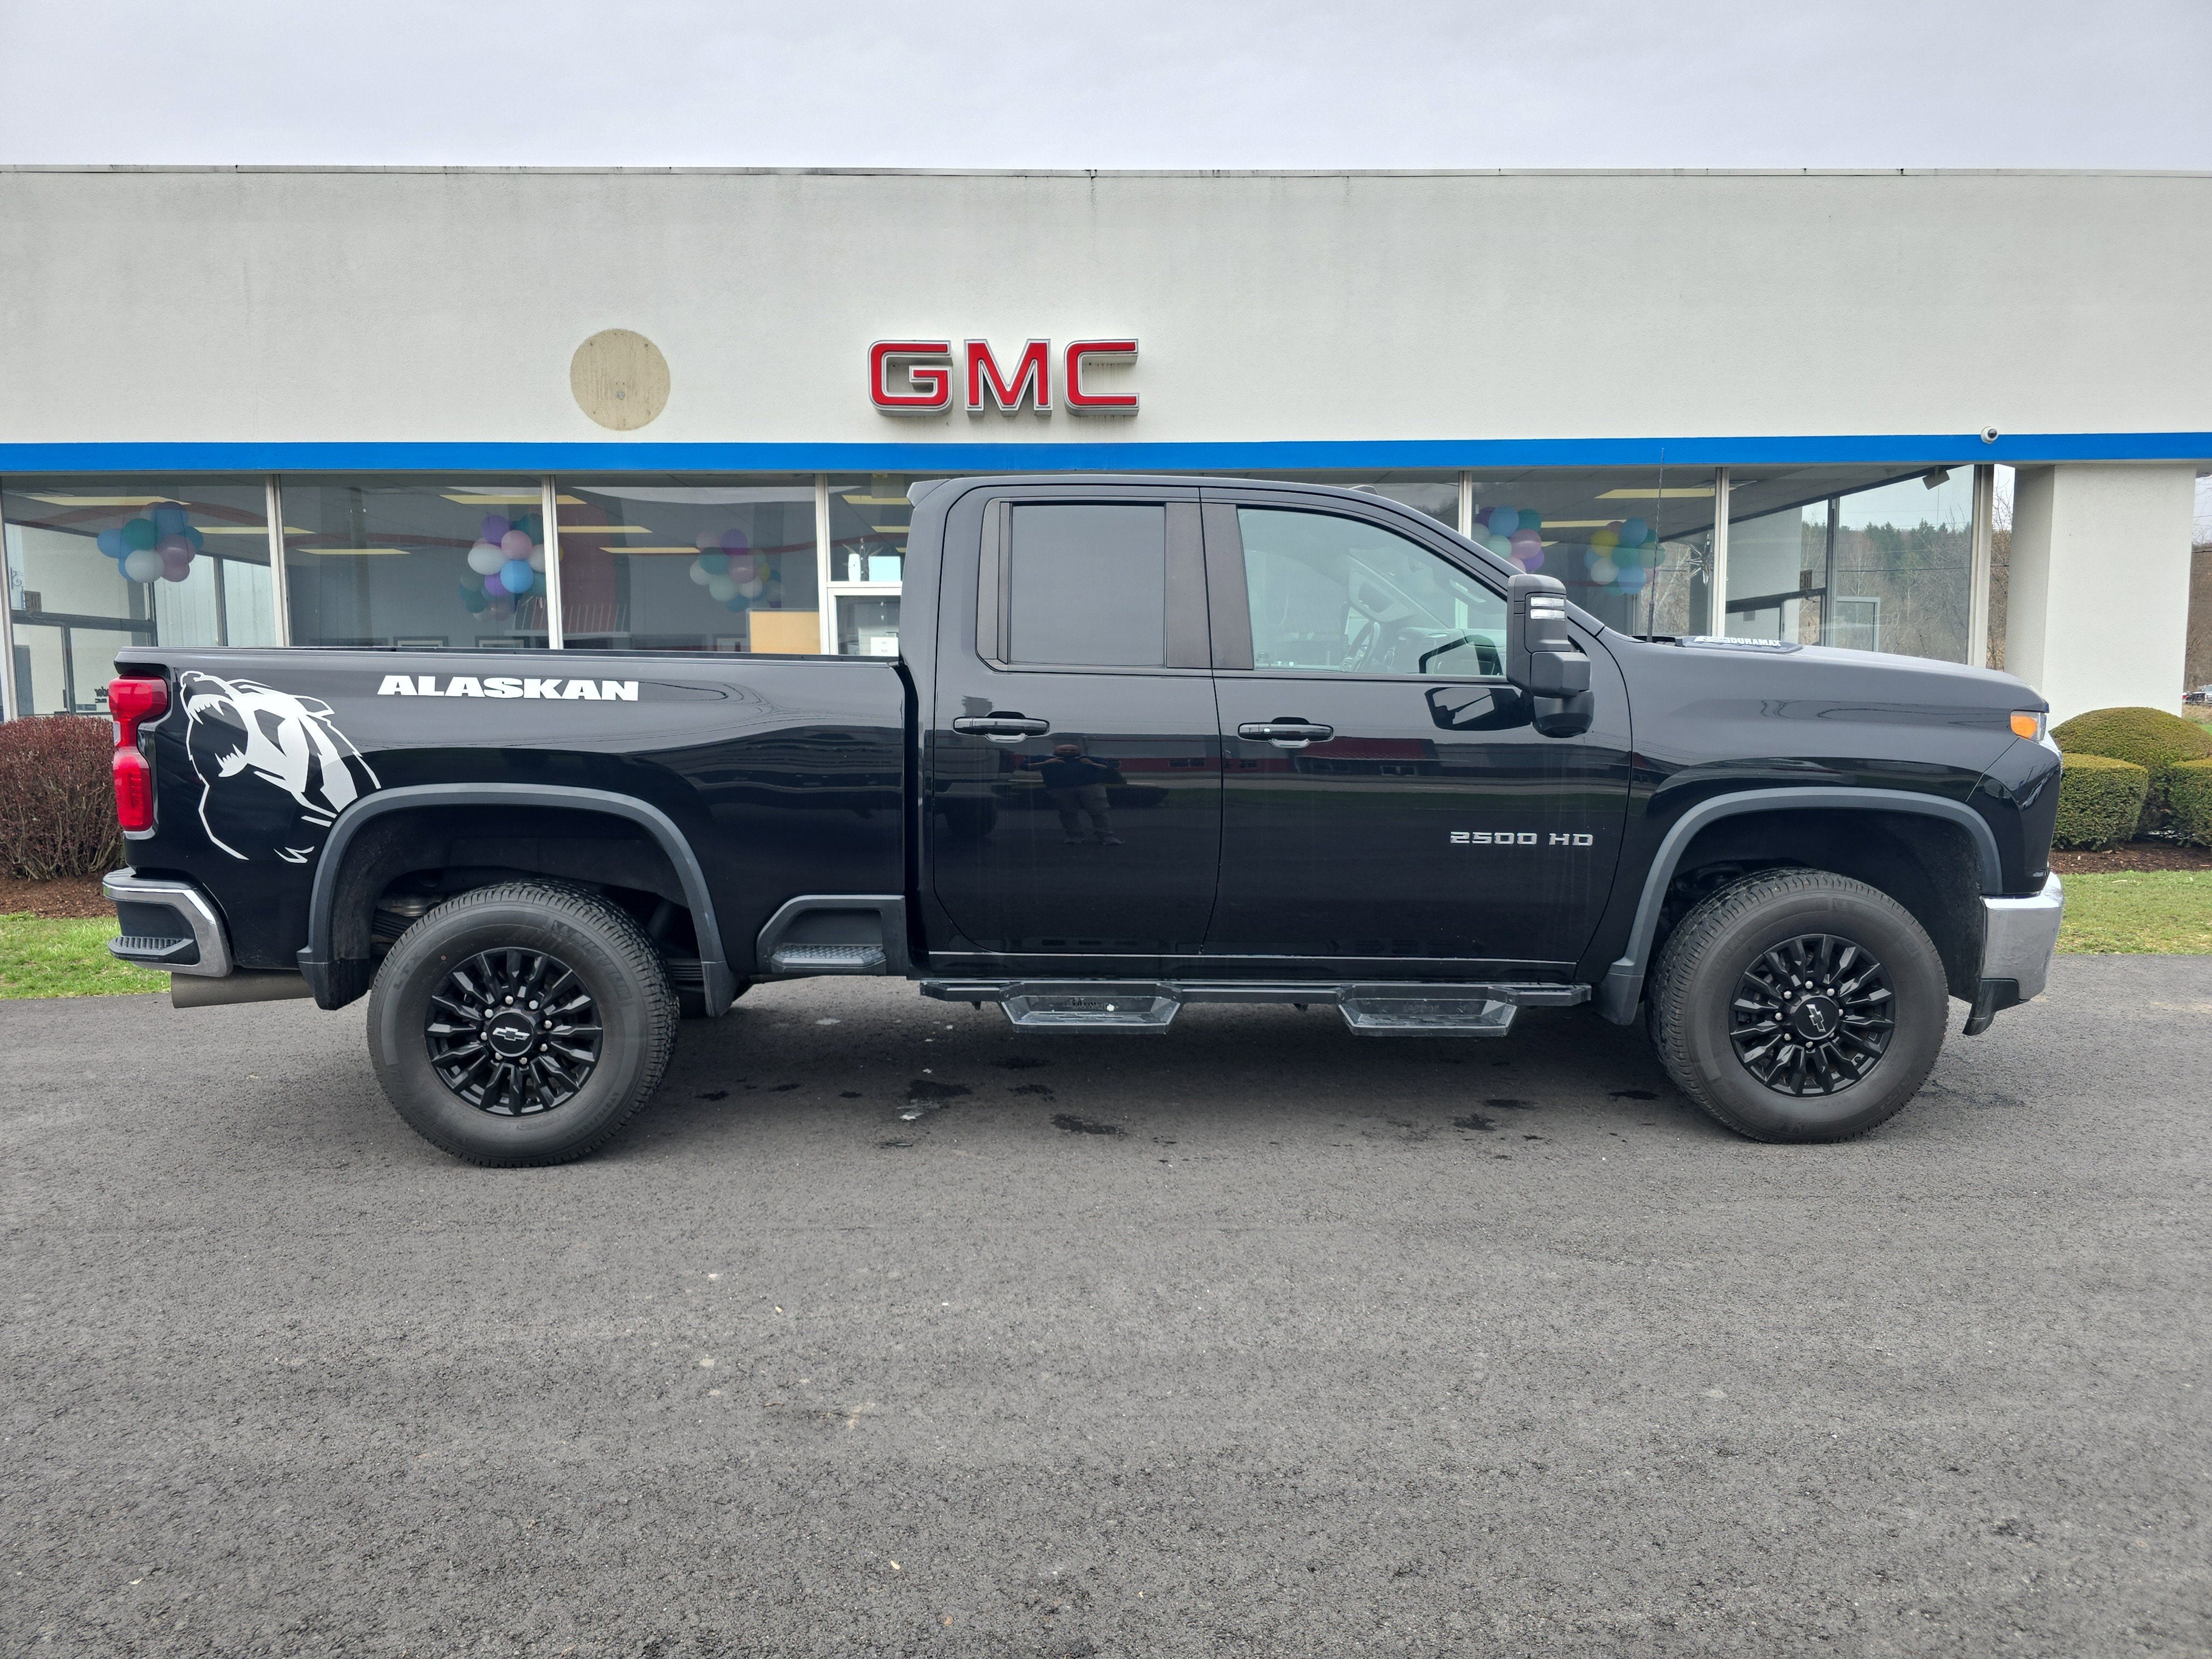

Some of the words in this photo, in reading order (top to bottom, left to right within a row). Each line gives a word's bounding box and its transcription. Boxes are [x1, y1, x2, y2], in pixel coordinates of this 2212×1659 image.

[867, 338, 1140, 414] GMC
[1729, 636, 1782, 647] DURAMAX
[377, 674, 639, 702] ALASKAN
[1450, 831, 1538, 845] 2500
[1548, 833, 1593, 846] HD
